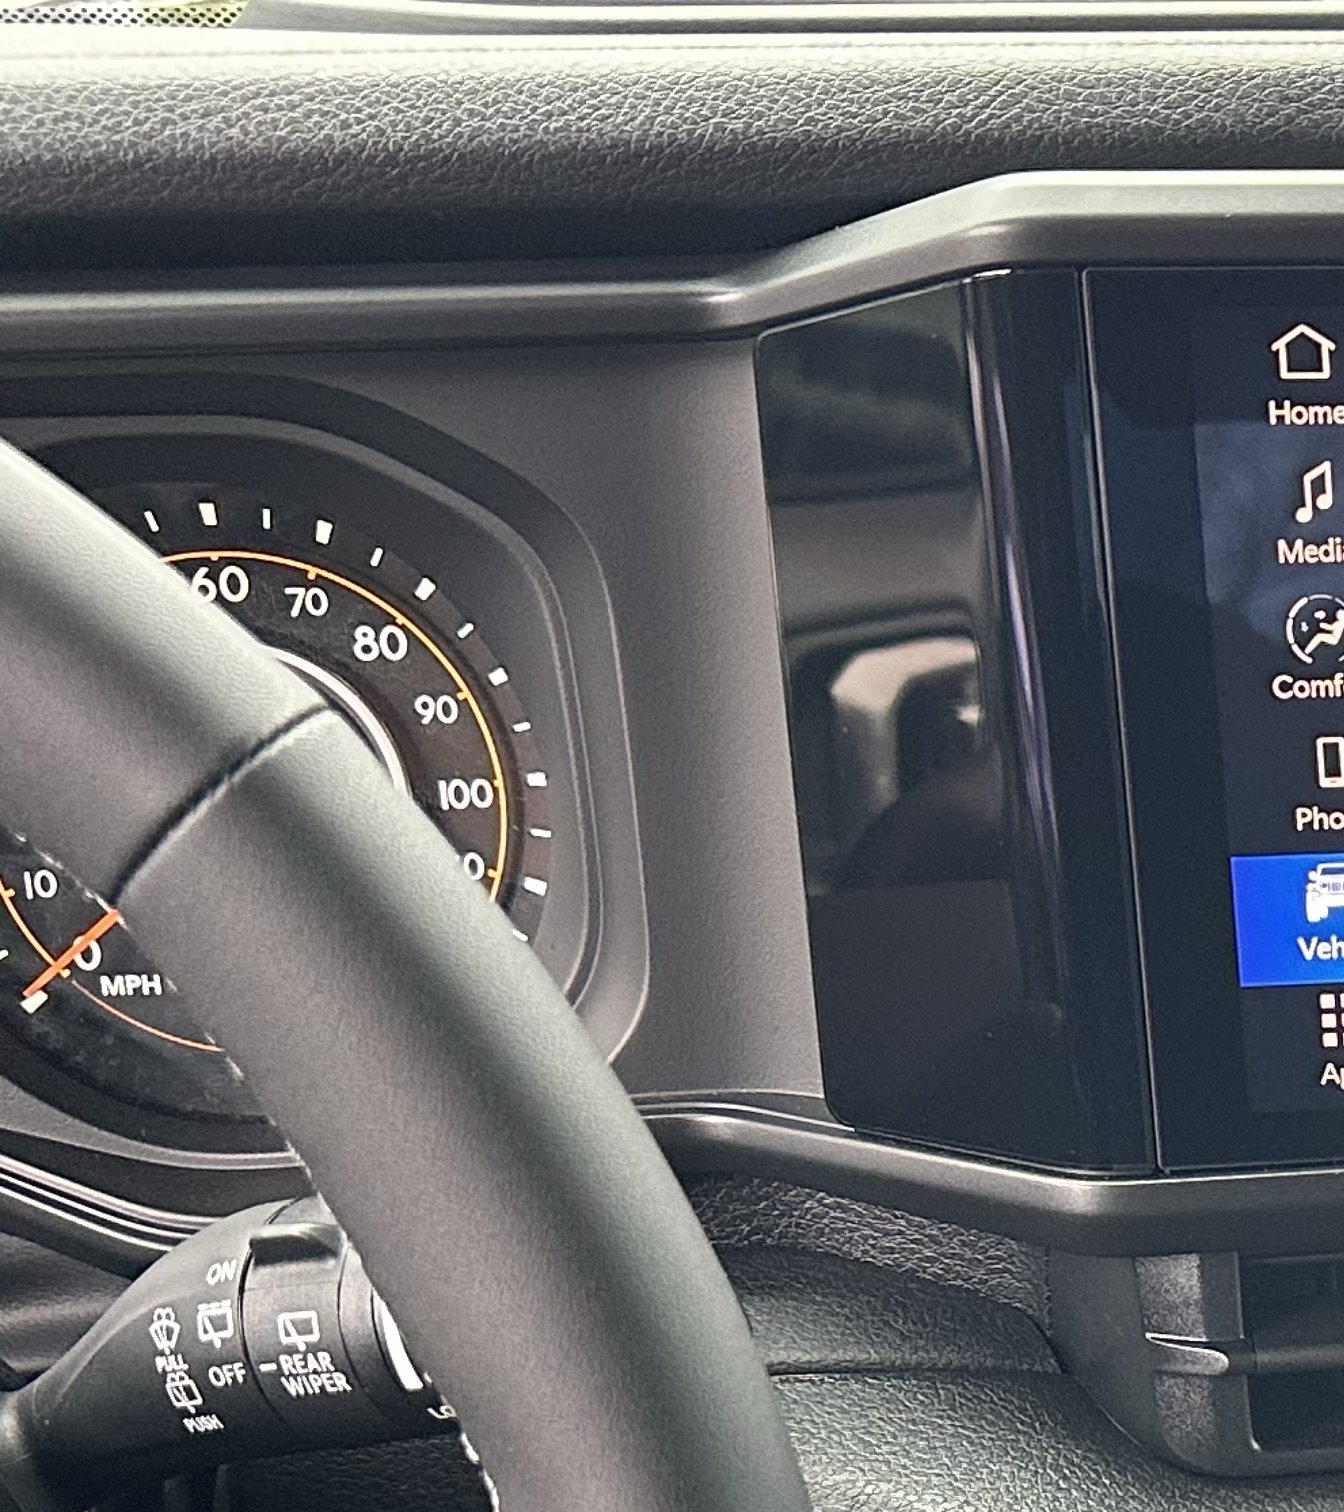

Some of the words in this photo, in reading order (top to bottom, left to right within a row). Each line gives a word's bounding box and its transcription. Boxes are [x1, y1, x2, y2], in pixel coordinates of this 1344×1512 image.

[190, 565, 249, 603] 60
[284, 587, 329, 617] 70
[353, 624, 408, 661] 80
[414, 694, 459, 725] 90
[437, 778, 494, 811] 100
[23, 869, 58, 900] 10
[100, 973, 162, 997] MPH
[206, 1261, 238, 1286] ON
[155, 1355, 189, 1373] PULL
[208, 1363, 247, 1388] OFF
[279, 1353, 336, 1374] REAR
[280, 1373, 352, 1397] WIPER
[183, 1413, 225, 1433] PUSH
